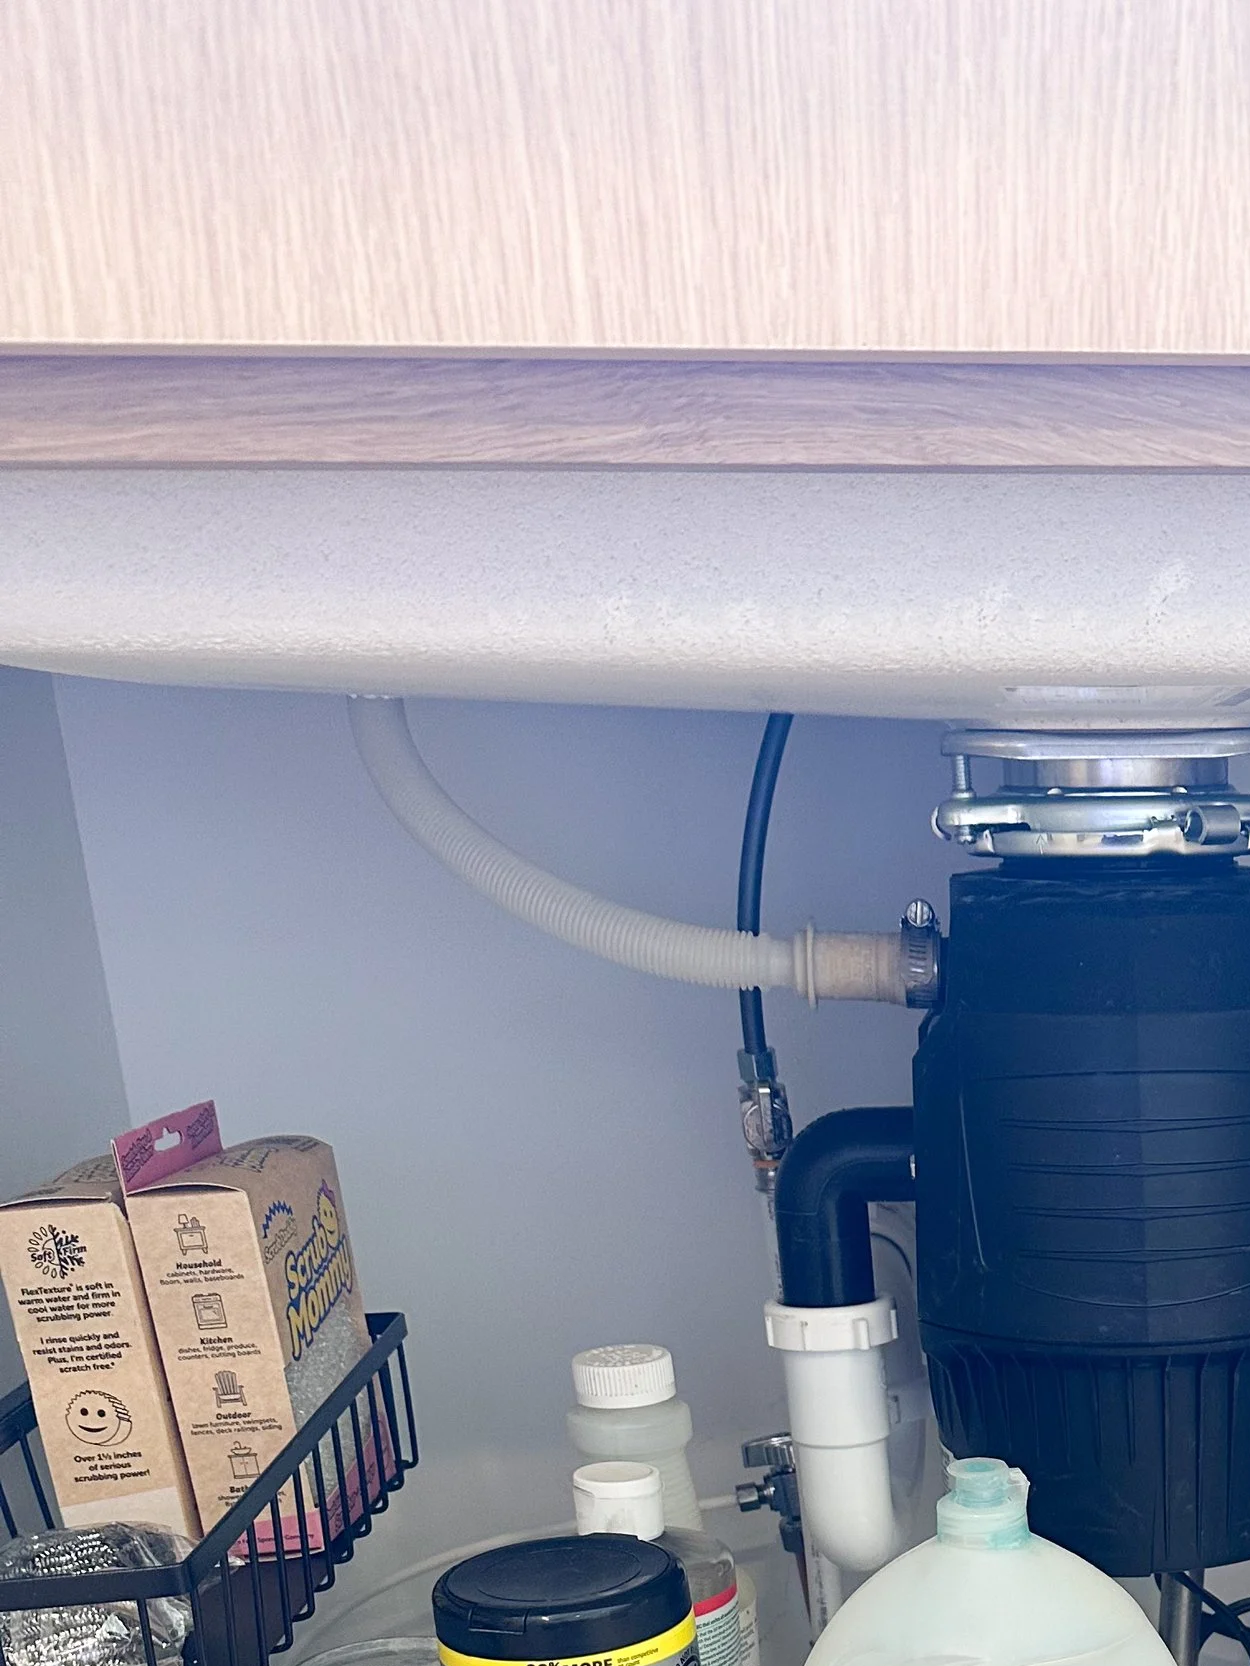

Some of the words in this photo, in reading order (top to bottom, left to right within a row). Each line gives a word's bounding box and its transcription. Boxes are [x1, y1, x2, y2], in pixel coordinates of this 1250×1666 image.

[30, 1251, 52, 1263] Soft
[285, 1214, 329, 1302] Scrub
[176, 1259, 222, 1270] Household
[75, 1284, 84, 1292] is
[85, 1283, 103, 1291] soft
[17, 1298, 44, 1306] warm
[45, 1295, 70, 1304] water
[72, 1292, 89, 1301] and
[91, 1291, 110, 1300] firm
[286, 1234, 353, 1362] Mommy
[27, 1306, 48, 1315] cool
[49, 1303, 75, 1312] water
[77, 1302, 90, 1310] for
[91, 1301, 116, 1309] more
[36, 1313, 82, 1323] scrubbing
[45, 1334, 67, 1344] rinse
[68, 1333, 101, 1343] quickly
[103, 1331, 120, 1340] and
[199, 1336, 234, 1345] Kitchen
[32, 1347, 57, 1356] resist
[58, 1344, 85, 1354] stains
[85, 1343, 102, 1352] and
[85, 1352, 122, 1362] certified
[59, 1365, 91, 1374] scratch
[215, 1411, 252, 1421] Outdoor
[73, 1454, 95, 1464] Over
[113, 1451, 142, 1459] inches
[88, 1464, 98, 1472] of
[100, 1462, 132, 1471] serious
[74, 1472, 118, 1483] scrubbing
